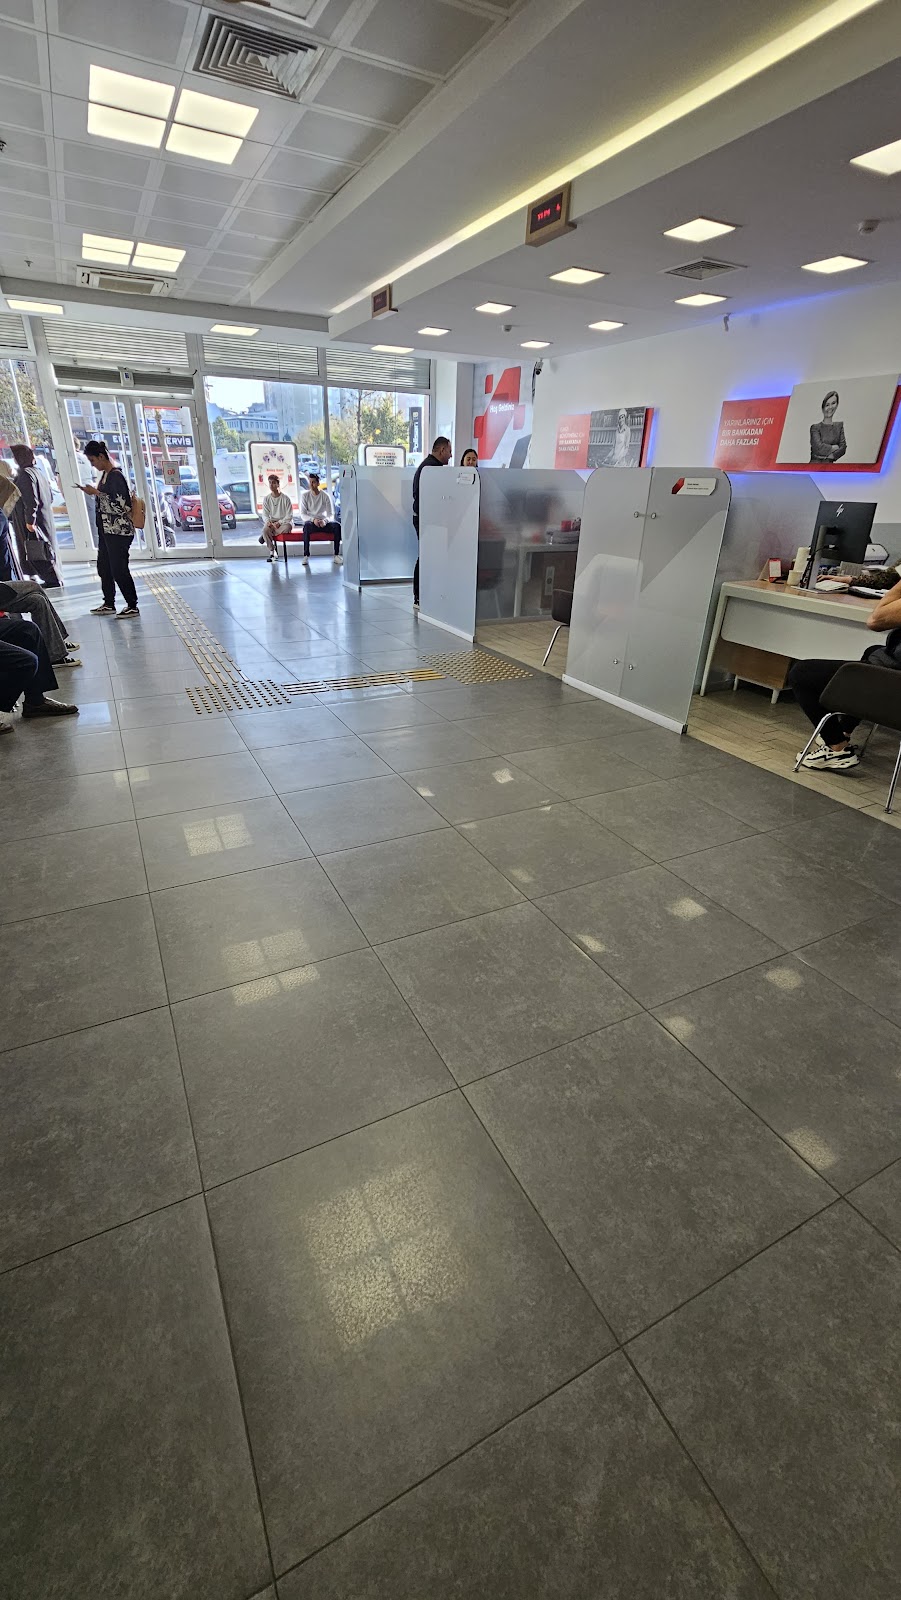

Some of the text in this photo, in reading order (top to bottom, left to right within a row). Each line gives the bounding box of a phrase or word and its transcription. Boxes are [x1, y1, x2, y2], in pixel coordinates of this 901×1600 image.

[498, 401, 515, 412] Geldiniz
[731, 427, 763, 436] BANKADAN
[165, 436, 192, 446] ERVİS
[719, 437, 759, 447] DAHA FAZLASI
